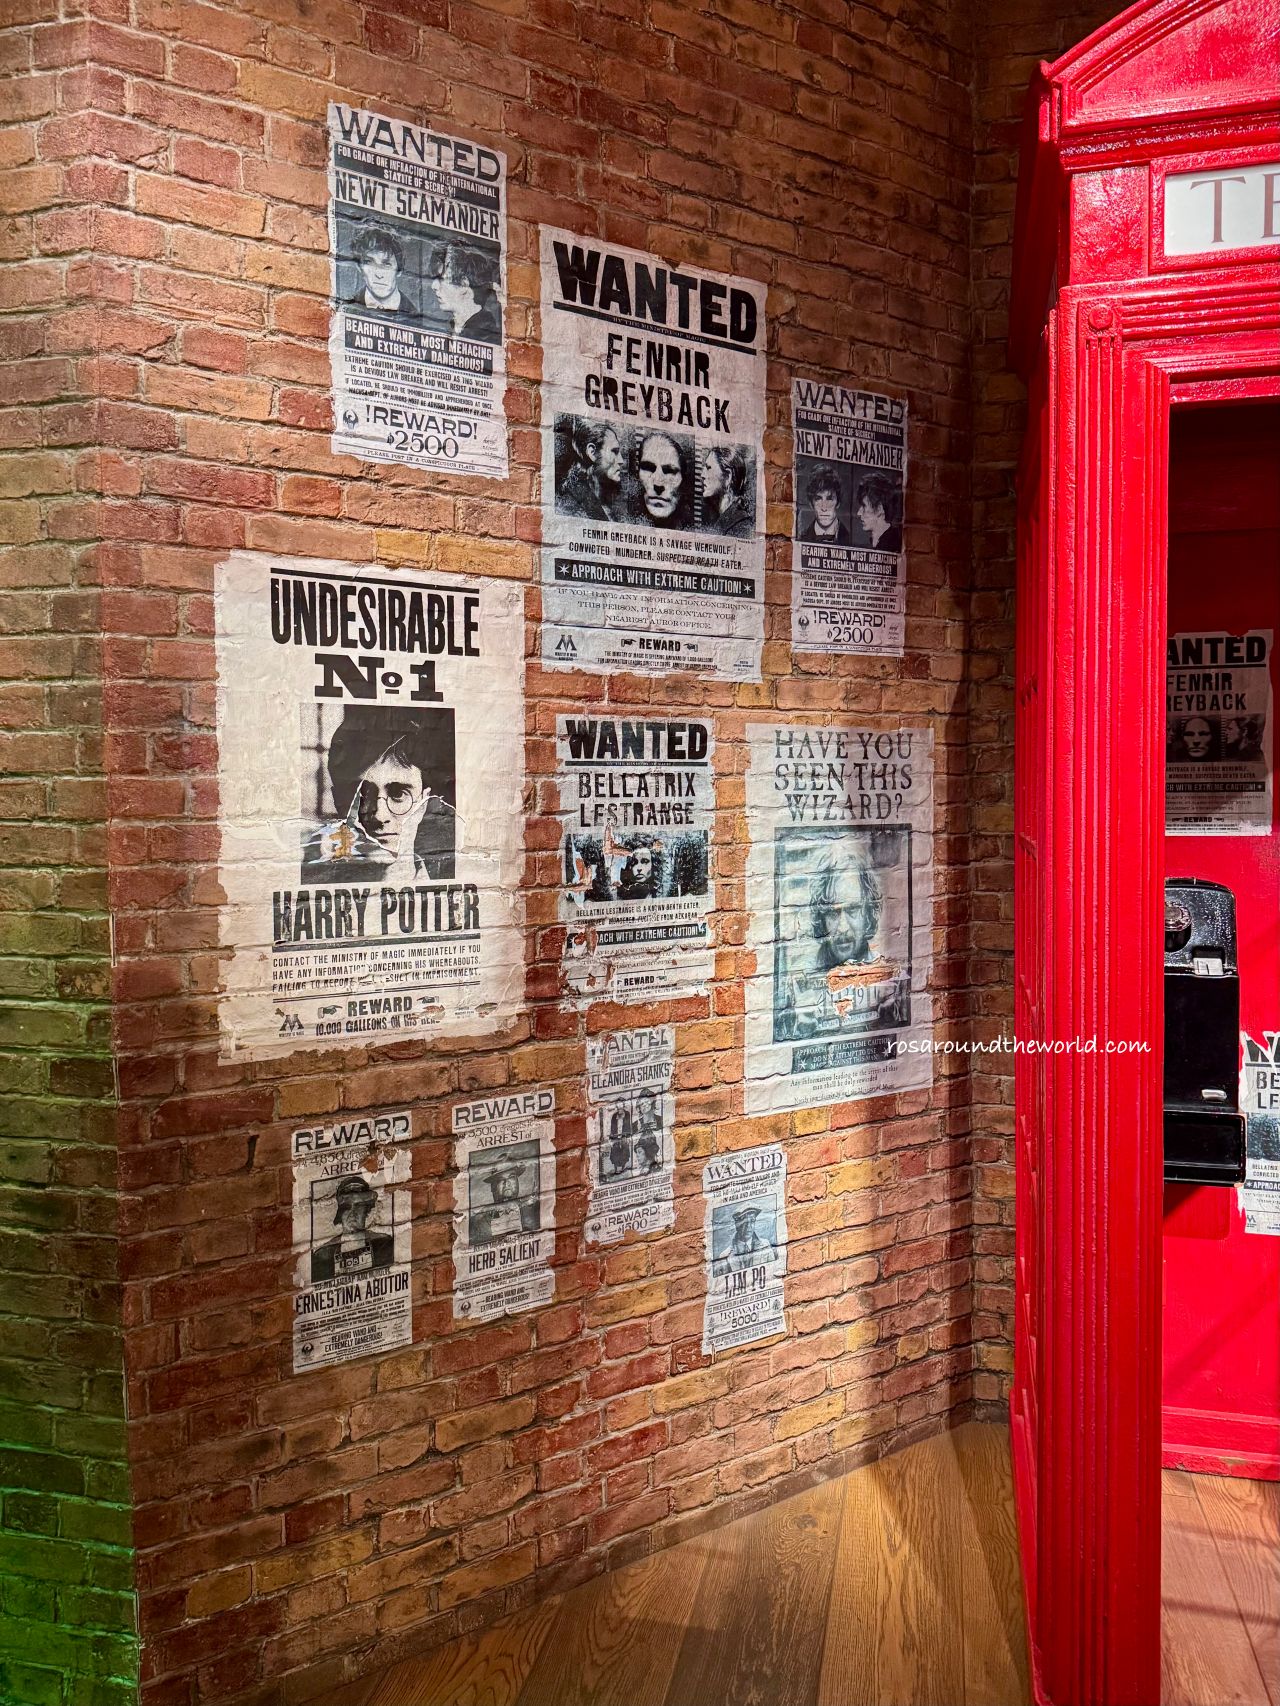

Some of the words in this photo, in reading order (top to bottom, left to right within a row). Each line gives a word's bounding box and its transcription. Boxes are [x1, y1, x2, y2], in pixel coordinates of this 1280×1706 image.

[336, 106, 500, 182] WANTED
[338, 145, 351, 158] FOR
[353, 150, 374, 164] GRADE
[376, 157, 388, 168] ONE
[390, 161, 427, 179] INFRACTION
[429, 170, 438, 180] OF
[451, 176, 496, 198] INTERNATIONAL
[414, 177, 423, 187] OF
[336, 170, 390, 210] NEWT
[397, 187, 499, 239] SCAMANDER
[553, 240, 757, 344] WANTED
[346, 320, 384, 338] BEARING
[390, 328, 416, 347] WAND,
[421, 335, 445, 349] MOST
[449, 339, 492, 360] MENACING
[355, 335, 373, 350] AND
[378, 339, 428, 360] EXTREMELY
[431, 351, 484, 372] DANGEROUS!
[345, 355, 368, 366] EXTREME
[371, 360, 393, 370] CAUTION
[396, 364, 415, 373] SHOULD
[417, 368, 423, 376] BE
[425, 368, 452, 381] EXERCISED
[453, 374, 461, 382] AS
[606, 333, 710, 389] FENRIR
[364, 368, 386, 378] DEVIOUS
[437, 381, 448, 390] WILL
[450, 383, 467, 393] RESIST
[585, 374, 730, 433] GREYBACK
[796, 380, 904, 424] WANTED
[796, 430, 832, 457] NEWT
[837, 438, 902, 469] SCAMANDER
[569, 542, 610, 555] CONVICTED
[657, 553, 694, 565] SUSPECTED
[582, 529, 608, 541] FENRIR
[610, 532, 647, 545] GREYBACK
[650, 537, 657, 545] IS
[659, 538, 664, 546] A
[666, 539, 692, 550] SAVAGE
[802, 546, 828, 556] BEARING
[851, 552, 867, 561] MOST
[572, 564, 623, 582] APPROACH
[626, 570, 650, 585] WITH
[655, 574, 698, 589] EXTREME
[701, 578, 742, 594] CAUTION!
[808, 558, 820, 567] AND
[823, 559, 854, 570] EXTREMELY
[858, 563, 892, 574] DANGEROUS!
[271, 577, 480, 657] UNDESIRABLE
[639, 638, 681, 652] REWARD
[1167, 636, 1266, 665] ANTED
[1167, 693, 1246, 712] REYBACK
[566, 720, 708, 759] WANTED
[775, 730, 848, 759] HAVE
[857, 732, 913, 760] YOU
[579, 773, 695, 798] BELLATRIX
[775, 763, 845, 791] SEEN
[853, 763, 913, 791] THIS
[580, 802, 694, 827] LESTRANGE
[785, 793, 902, 822] WIZARD?
[273, 888, 370, 941] HARRY
[380, 884, 480, 935] POTTER
[576, 908, 605, 917] BELLATRIX
[606, 906, 634, 914] LESTRANGE
[616, 933, 633, 941] WITH
[636, 930, 666, 939] EXTREME
[668, 926, 698, 937] CAUTION!
[273, 956, 310, 967] CONTACT
[314, 955, 328, 964] THE
[332, 952, 367, 963] MINISTRY
[371, 951, 379, 960] OF
[382, 950, 405, 959] MAGIC
[408, 946, 456, 957] IMMEDIATELY
[460, 945, 466, 953] IF
[468, 944, 480, 953] YOU
[273, 970, 293, 980] HAVE
[298, 969, 312, 978] ANY
[369, 961, 412, 972] CONCERNING
[415, 960, 426, 968] HIS
[624, 976, 654, 986] REWARD
[272, 982, 306, 992] FAILING
[311, 980, 319, 989] TO
[348, 996, 413, 1017] REWARD
[346, 1016, 387, 1033] GALLEONS
[638, 1063, 669, 1081] SHANKS
[455, 1093, 552, 1126] REWARD
[295, 1116, 409, 1152] REWARD
[477, 1131, 524, 1148] ARREST
[707, 1152, 782, 1180] WANTED
[469, 1251, 495, 1273] HERB
[500, 1239, 541, 1265] SALIENT
[295, 1284, 361, 1315] ERNESTINA
[365, 1272, 408, 1299] ABUTOR
[725, 1270, 747, 1299] LIM
[752, 1266, 765, 1291] PO
